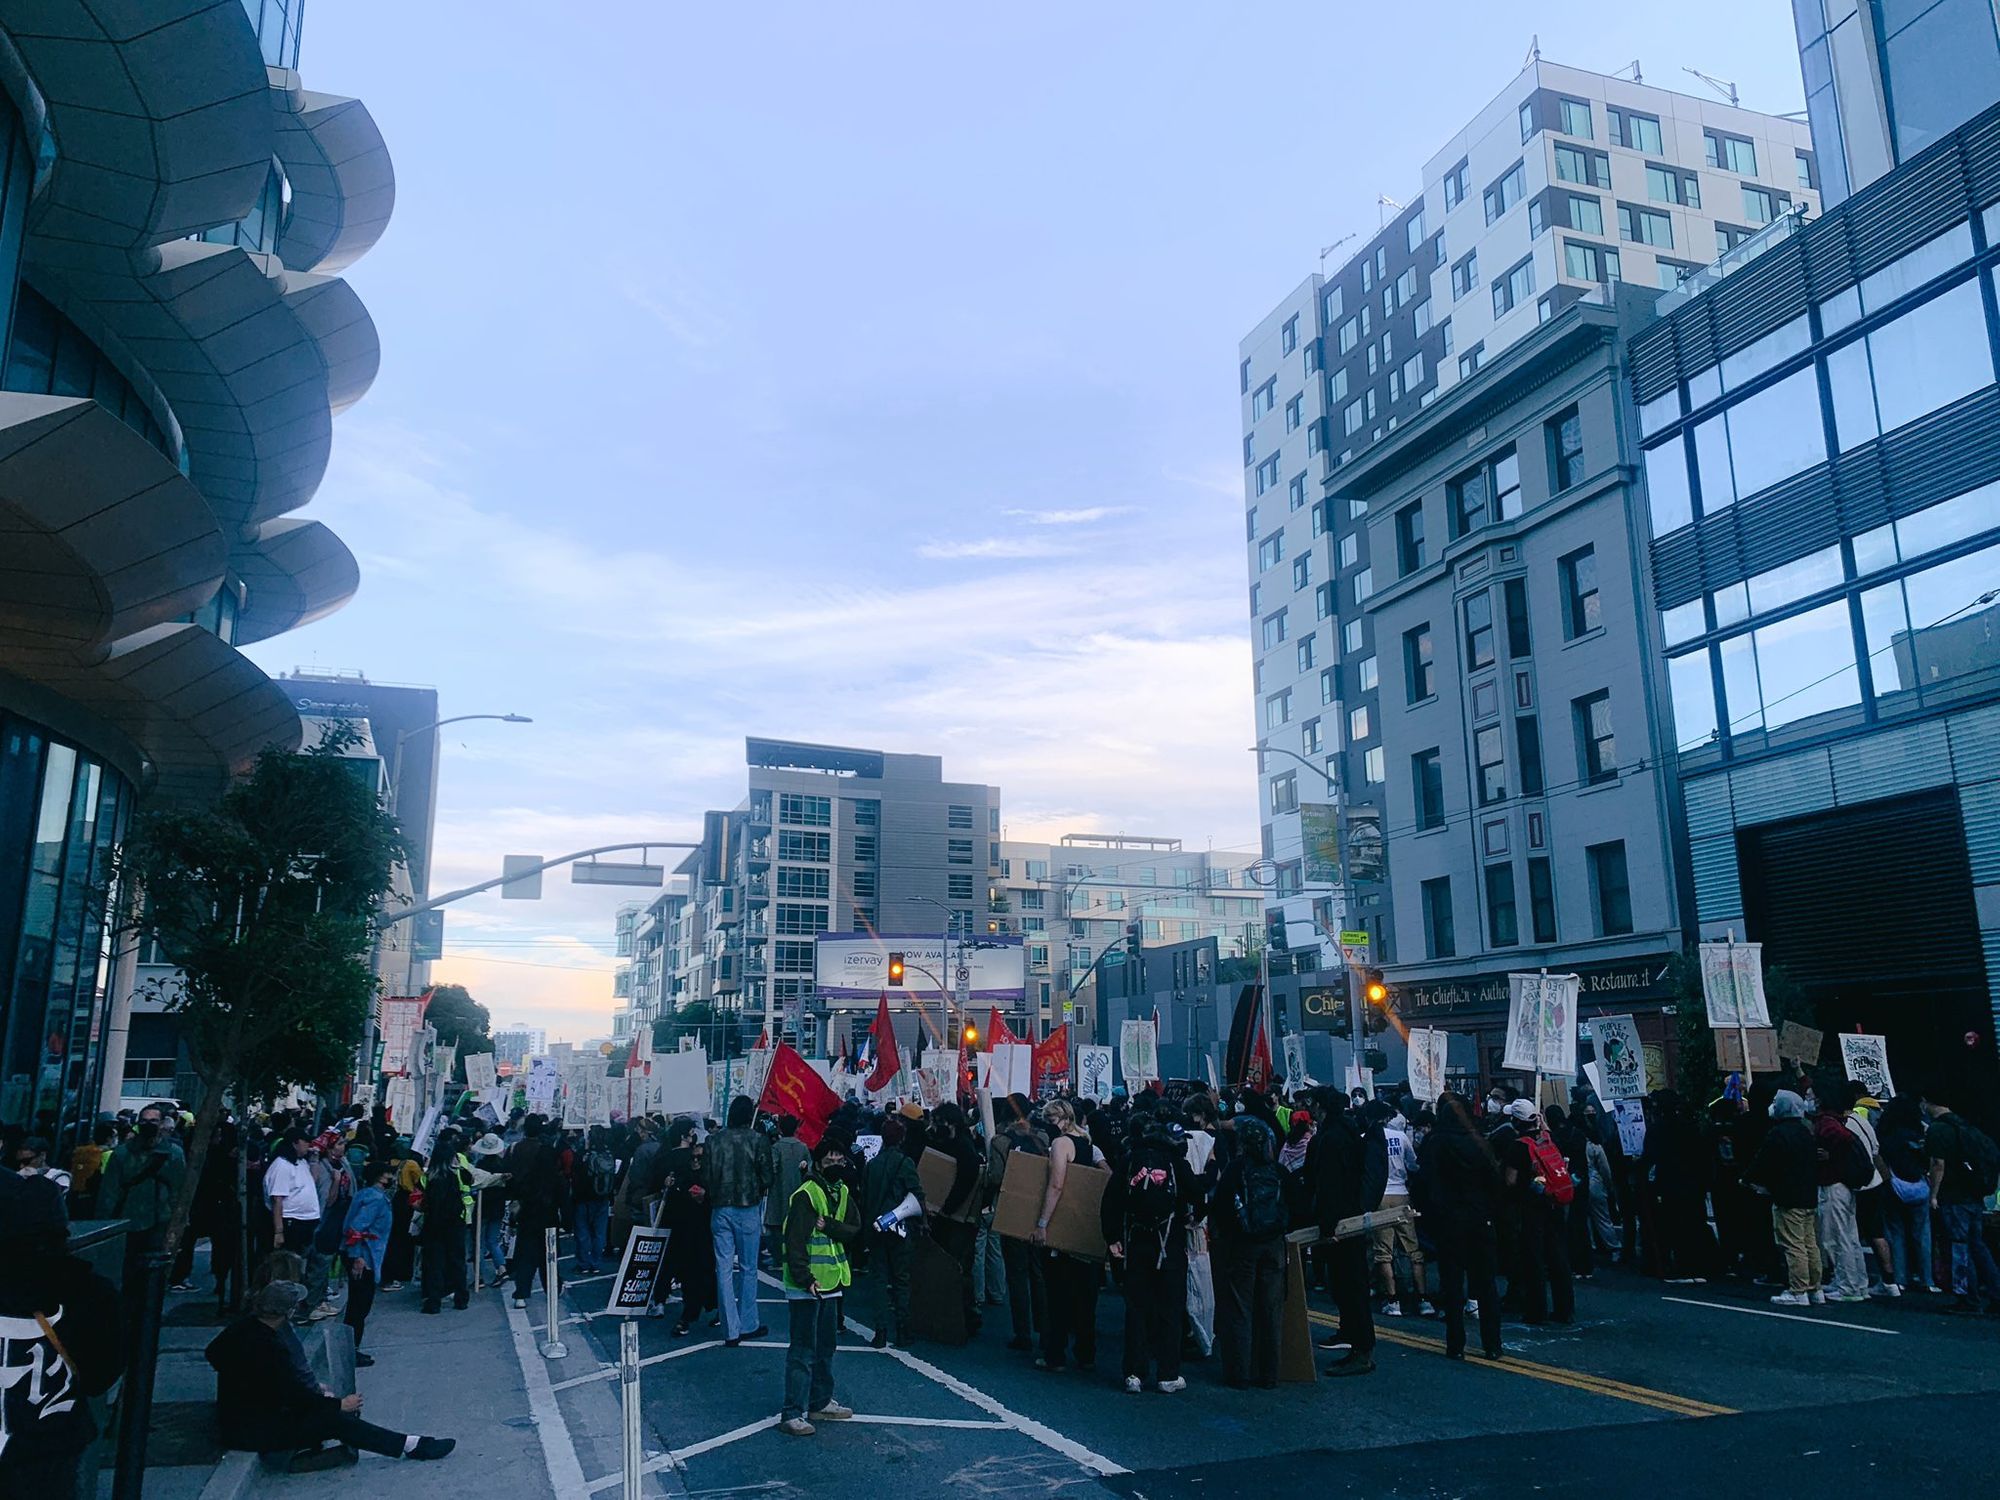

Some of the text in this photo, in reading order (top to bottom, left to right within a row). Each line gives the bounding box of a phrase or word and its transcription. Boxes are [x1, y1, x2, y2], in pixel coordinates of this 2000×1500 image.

[843, 955, 883, 967] izervay
[925, 951, 974, 960] AVALALE
[1415, 987, 1429, 1006] The
[1599, 1023, 1622, 1034] PEOPLE
[637, 1240, 663, 1254] GREED
